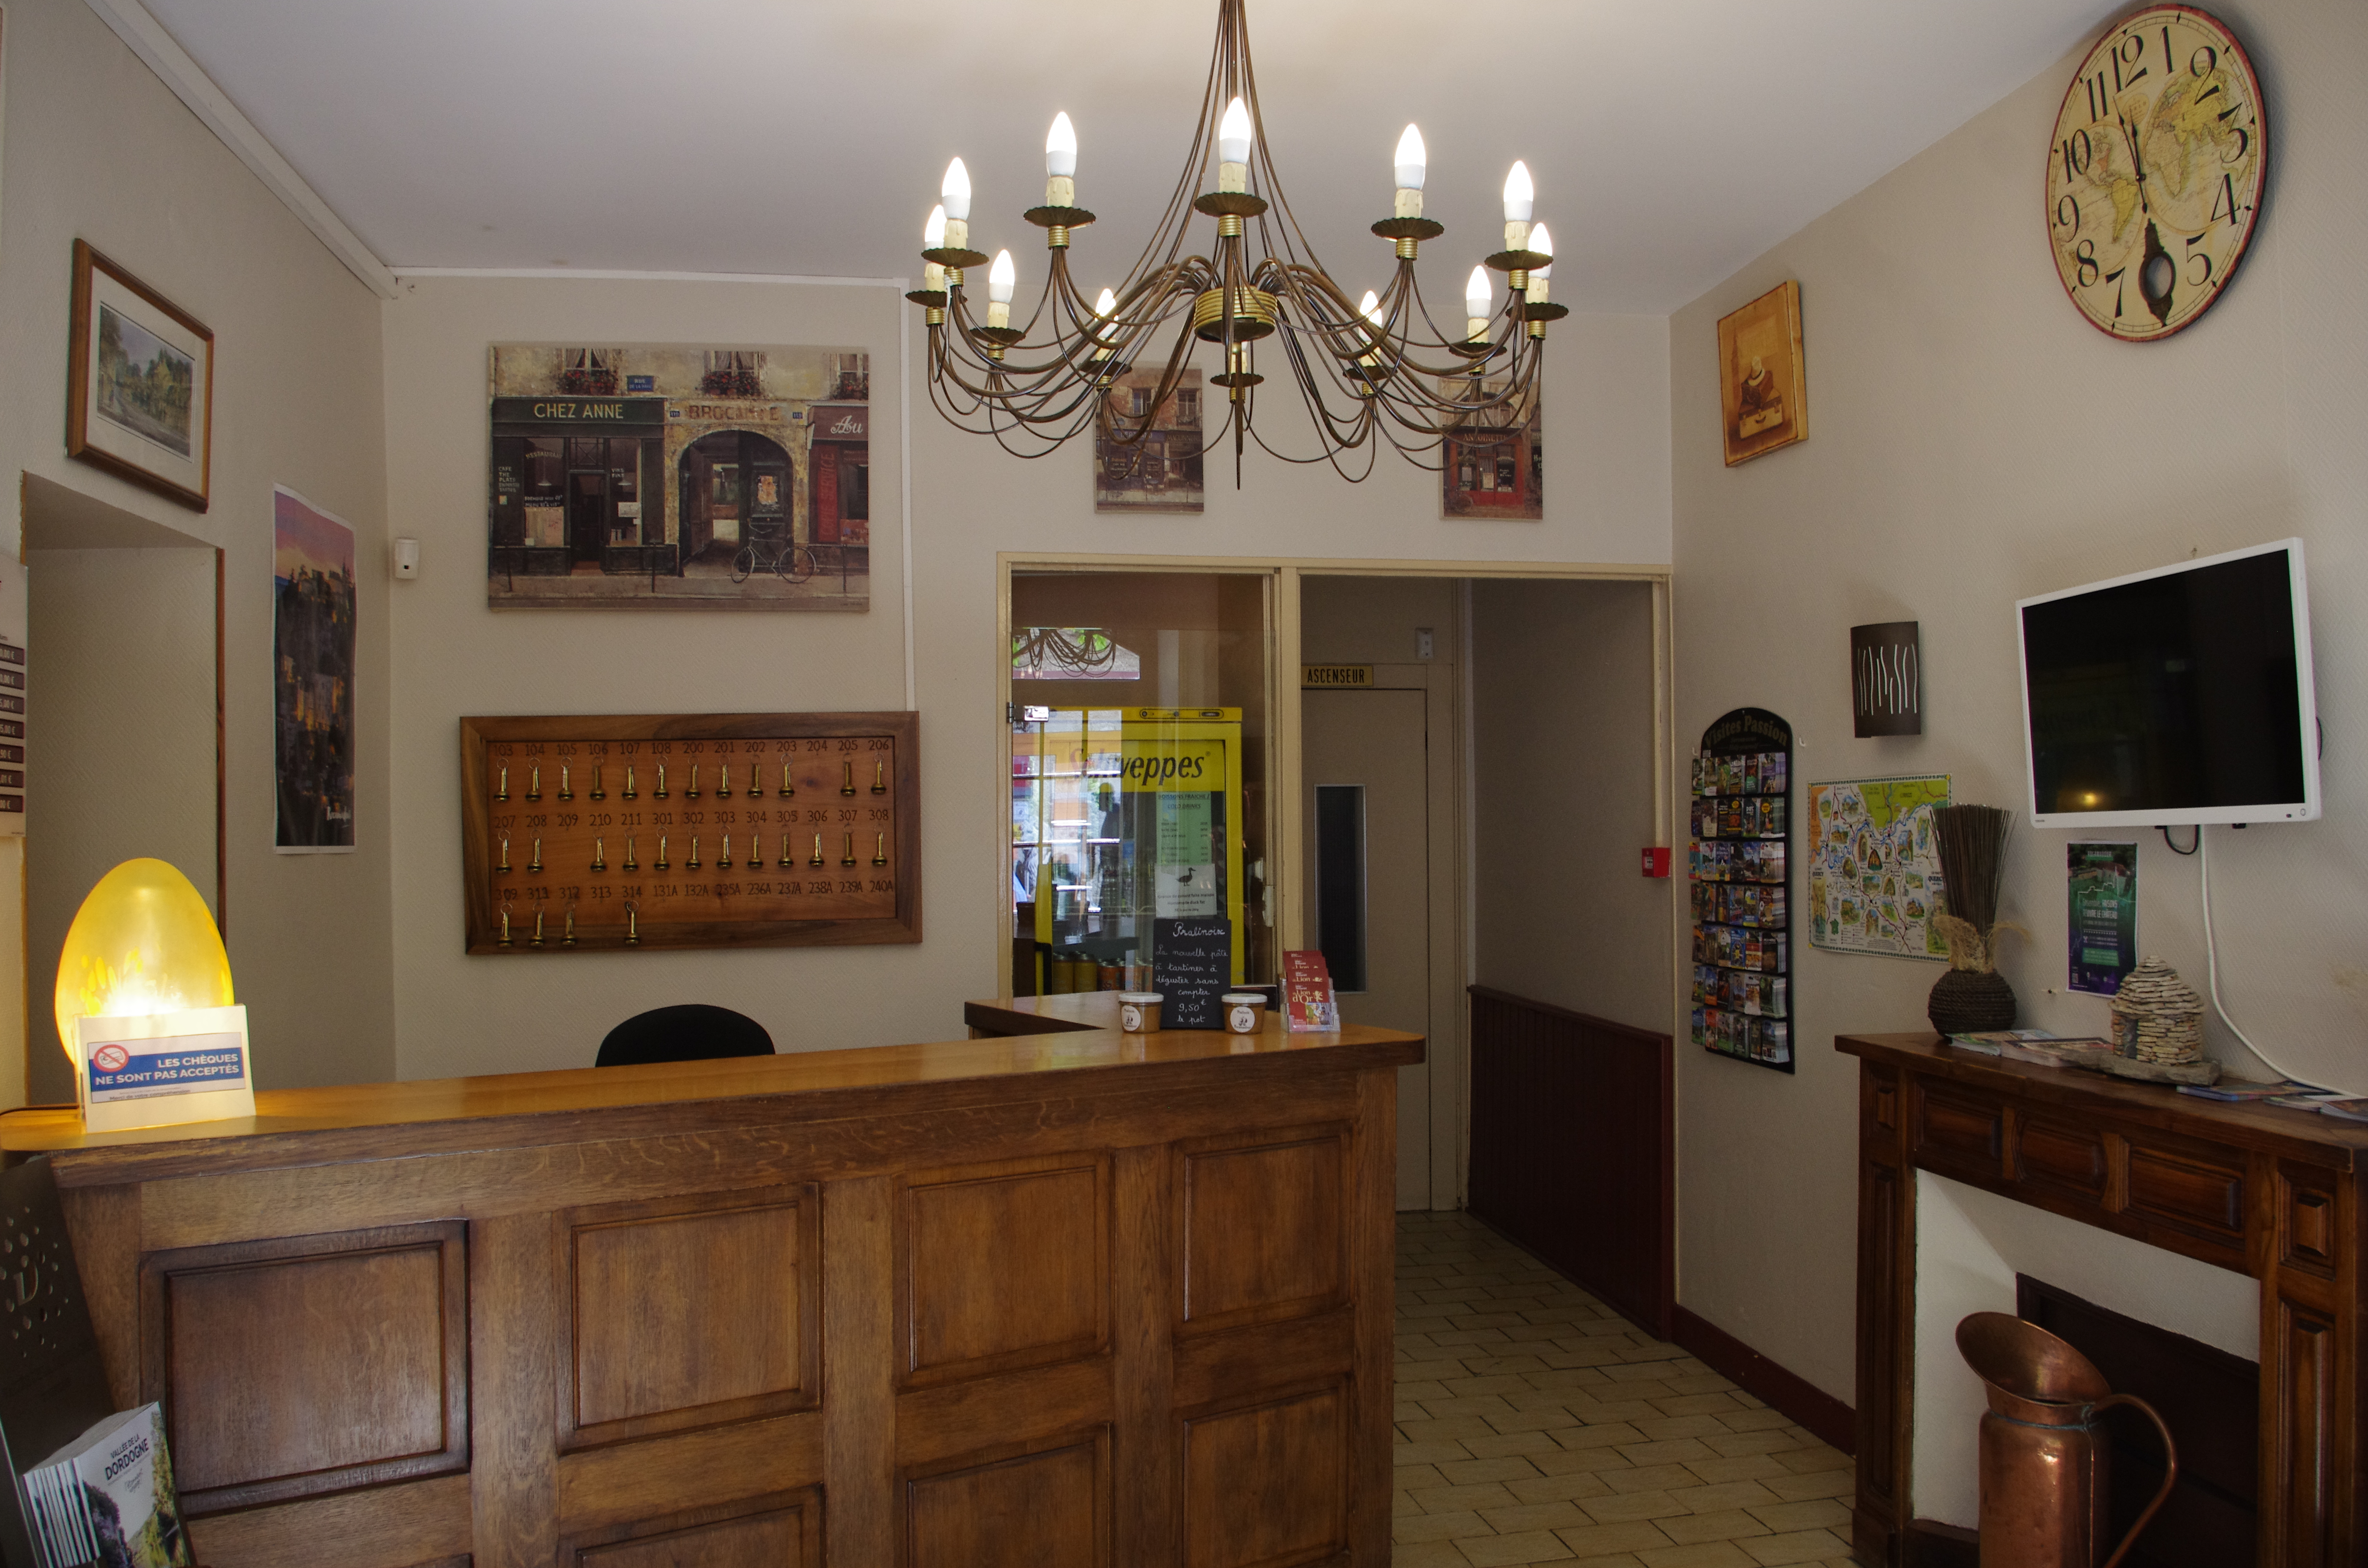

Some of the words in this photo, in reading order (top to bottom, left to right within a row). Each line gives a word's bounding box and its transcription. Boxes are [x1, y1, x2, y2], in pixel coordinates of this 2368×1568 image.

[2159, 26, 2176, 76] 1
[2109, 35, 2148, 95] 12
[2189, 46, 2220, 105] 2
[2084, 71, 2110, 123] 11
[2218, 102, 2248, 163] 3
[2062, 128, 2091, 184] 10
[2210, 173, 2241, 227] 4
[2058, 195, 2079, 243] 9
[2076, 239, 2098, 288] 8
[2186, 232, 2211, 286] 5
[2105, 266, 2125, 319] 7
[534, 404, 576, 419] CHEZ
[582, 404, 624, 419] ANNE
[1463, 433, 1507, 441] ANOINETTE
[1307, 669, 1364, 683] ASCENSEUR
[1705, 720, 1741, 748] Visites
[1744, 715, 1787, 747] Passion
[494, 745, 513, 756] 103
[526, 744, 545, 756] 104
[556, 744, 577, 755] 105
[589, 744, 608, 755] 106
[620, 743, 640, 754] 107
[652, 742, 671, 754] 108
[683, 742, 704, 753] 200
[715, 742, 734, 753] 201
[745, 742, 765, 752] 202
[777, 741, 796, 752] 203
[807, 740, 827, 751] 204
[838, 740, 858, 751] 205
[868, 739, 888, 750] 206
[495, 816, 516, 828] 207
[526, 815, 546, 827] 208
[558, 814, 578, 826] 209
[590, 814, 611, 825] 210
[621, 813, 641, 825] 211
[653, 812, 673, 825] 301
[684, 812, 704, 824] 302
[715, 812, 735, 823] 303
[747, 811, 767, 823] 304
[777, 810, 798, 822] 305
[808, 810, 827, 821] 306
[839, 810, 857, 821] 307
[869, 809, 888, 821] 308
[496, 889, 517, 901] 309
[528, 887, 549, 899] 311
[591, 886, 611, 898] 313
[622, 886, 642, 897] 314
[654, 885, 678, 897] 131A
[685, 885, 709, 896] 132A
[747, 883, 771, 895] 236A
[777, 882, 801, 894] 237A
[808, 882, 832, 894] 238A
[839, 881, 863, 893] 239A
[870, 881, 893, 893] 240A
[1156, 944, 1168, 955] La
[1172, 948, 1206, 957] nouvelle
[1168, 963, 1204, 971] tartiner
[1157, 975, 1189, 986] déguster
[1178, 989, 1210, 998] compter
[1293, 995, 1313, 1004] d'Or
[1189, 1016, 1206, 1025] pot
[157, 1058, 180, 1068] LES
[182, 1054, 238, 1065] CHÈQUES
[95, 1076, 114, 1086] NE
[116, 1072, 152, 1084] SONT
[154, 1069, 178, 1080] PAS
[179, 1065, 240, 1078] ACCEPTÉS
[128, 1437, 135, 1447] DE
[134, 1433, 140, 1443] LA
[105, 1438, 149, 1481] DORDOGNE
